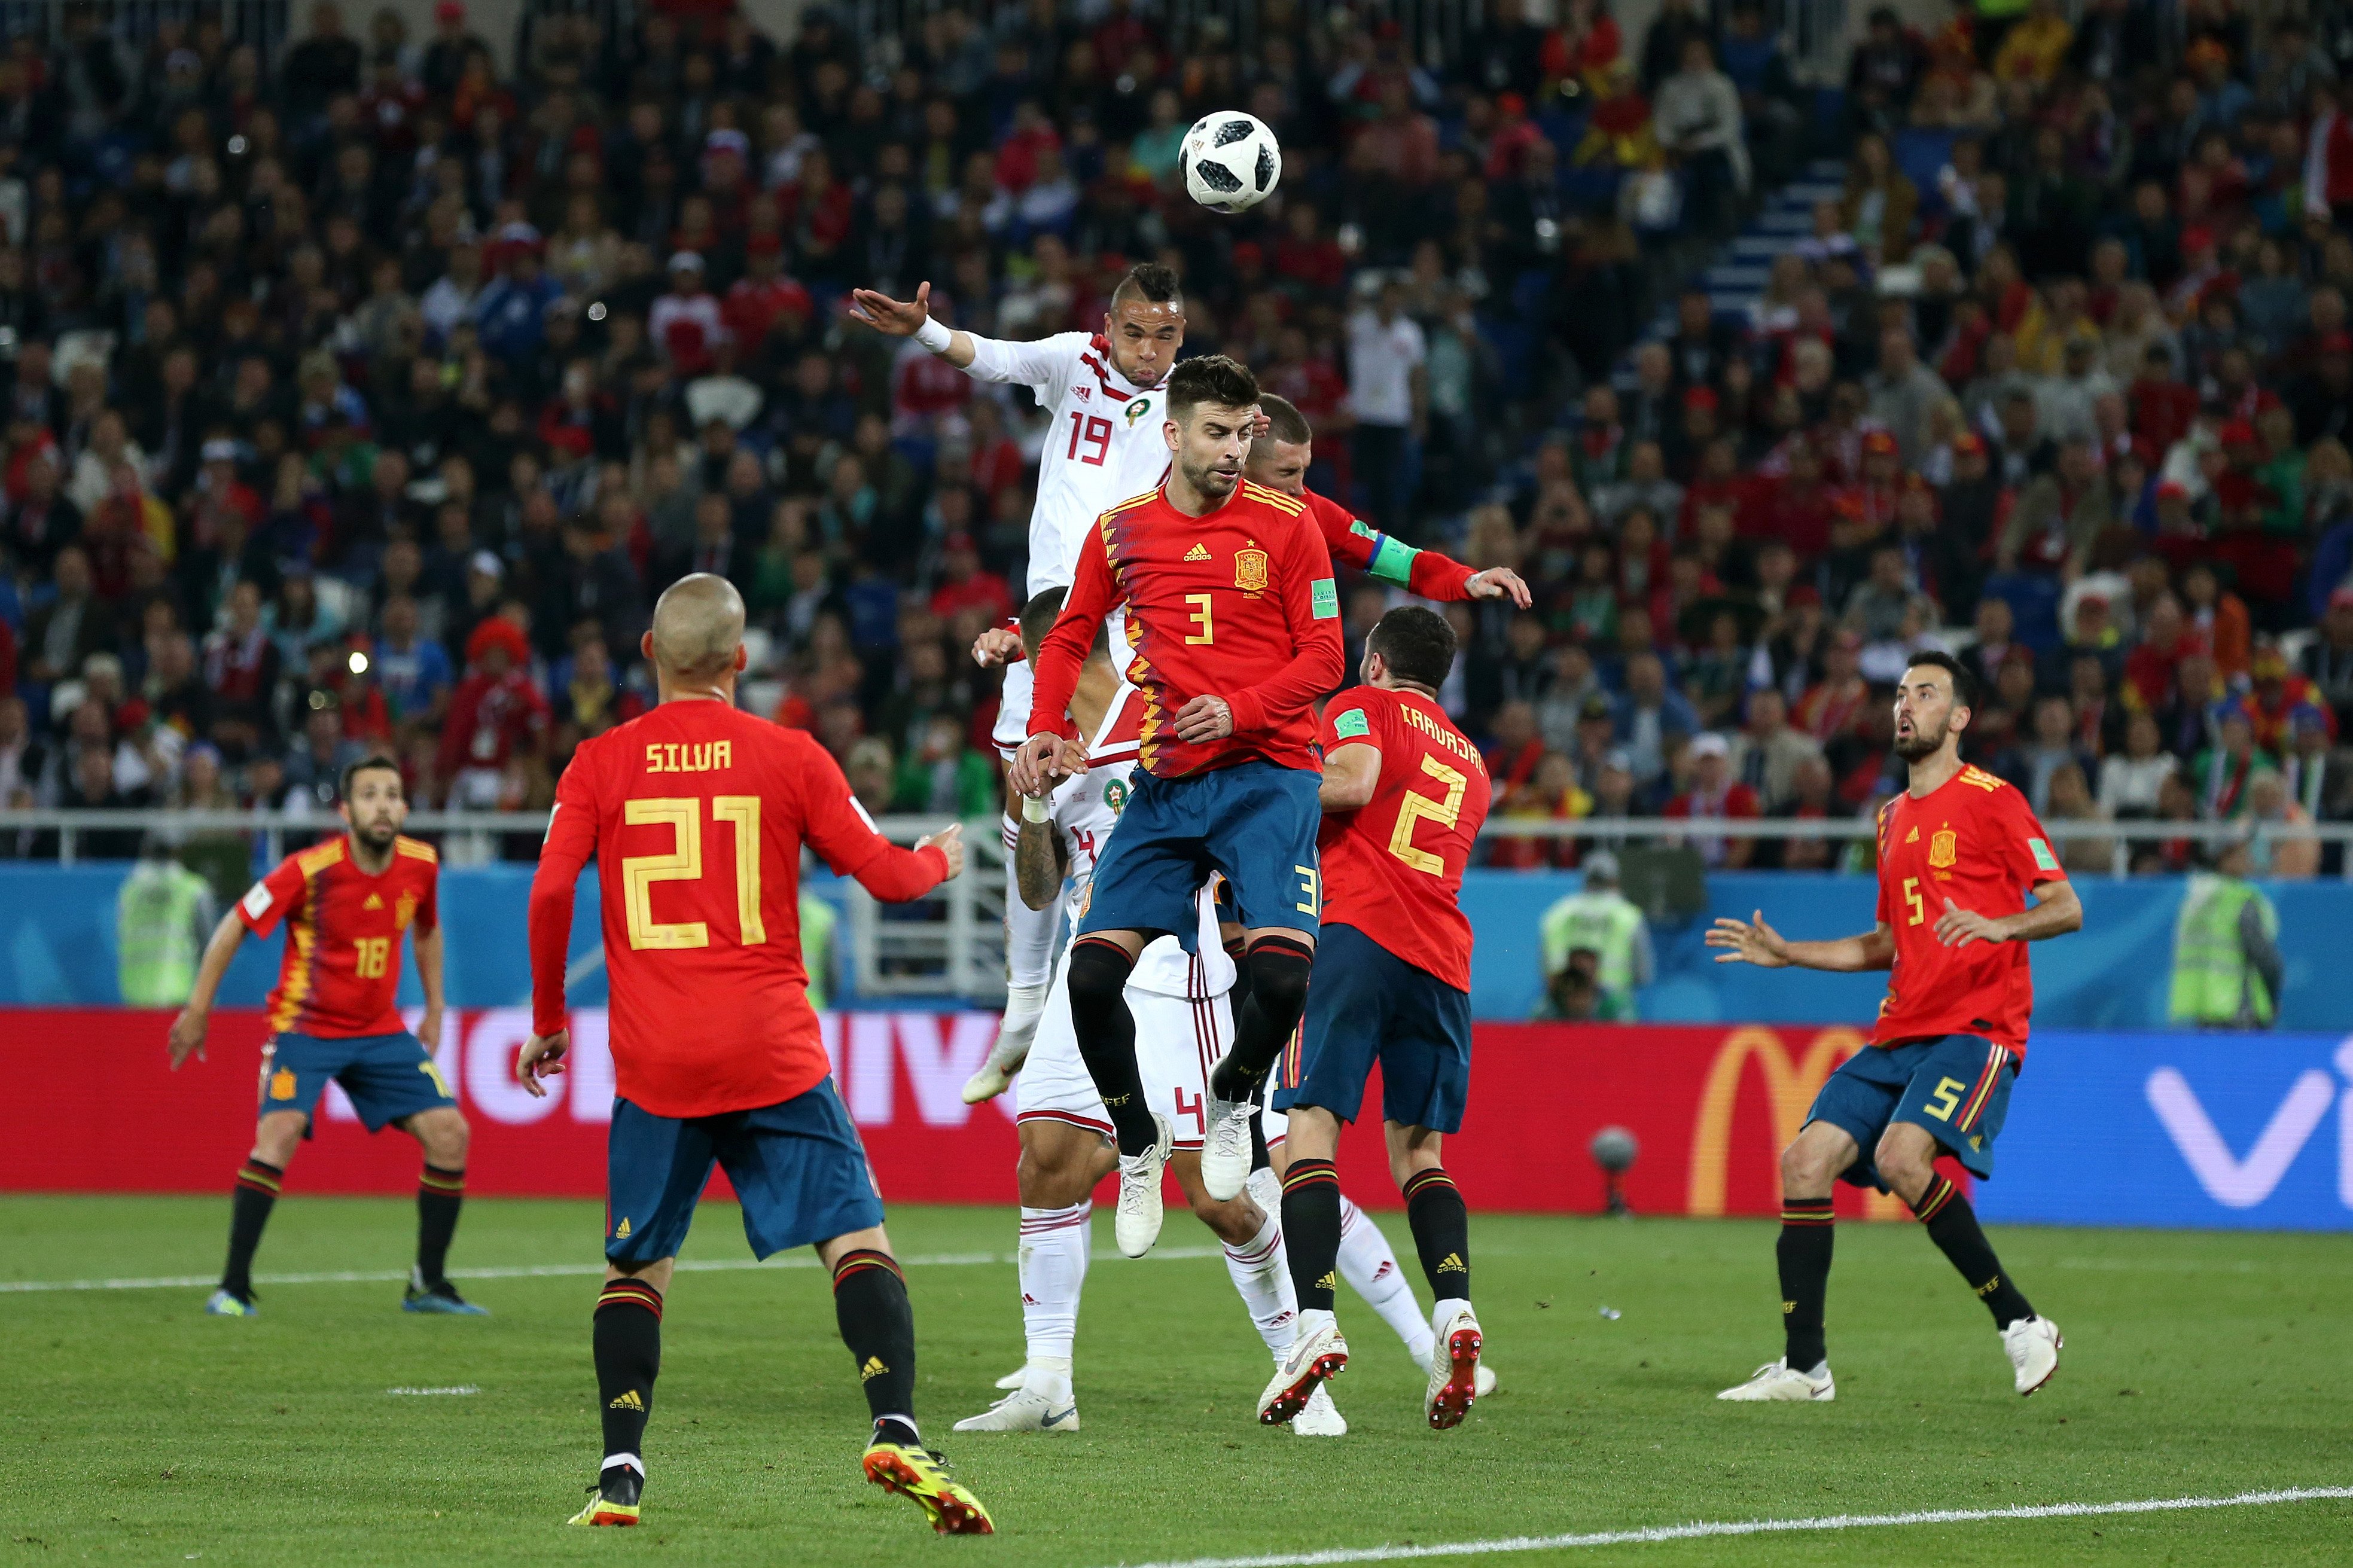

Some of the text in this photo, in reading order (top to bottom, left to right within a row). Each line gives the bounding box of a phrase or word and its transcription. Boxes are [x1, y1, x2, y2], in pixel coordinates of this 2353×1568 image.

[1067, 411, 1113, 467] 19
[1185, 593, 1214, 645] 3
[646, 739, 732, 774] SILVA
[1388, 751, 1468, 878] 2
[1069, 820, 1098, 869] 4
[621, 795, 767, 951] 21
[1294, 864, 1317, 918] 3
[1903, 877, 1925, 926] 5
[353, 937, 391, 979] 18
[1174, 1087, 1205, 1134] 4
[1923, 1076, 1967, 1122] 5
[1315, 1283, 1335, 1291] adid
[861, 1367, 889, 1385] didas
[610, 1402, 645, 1412] adidas
